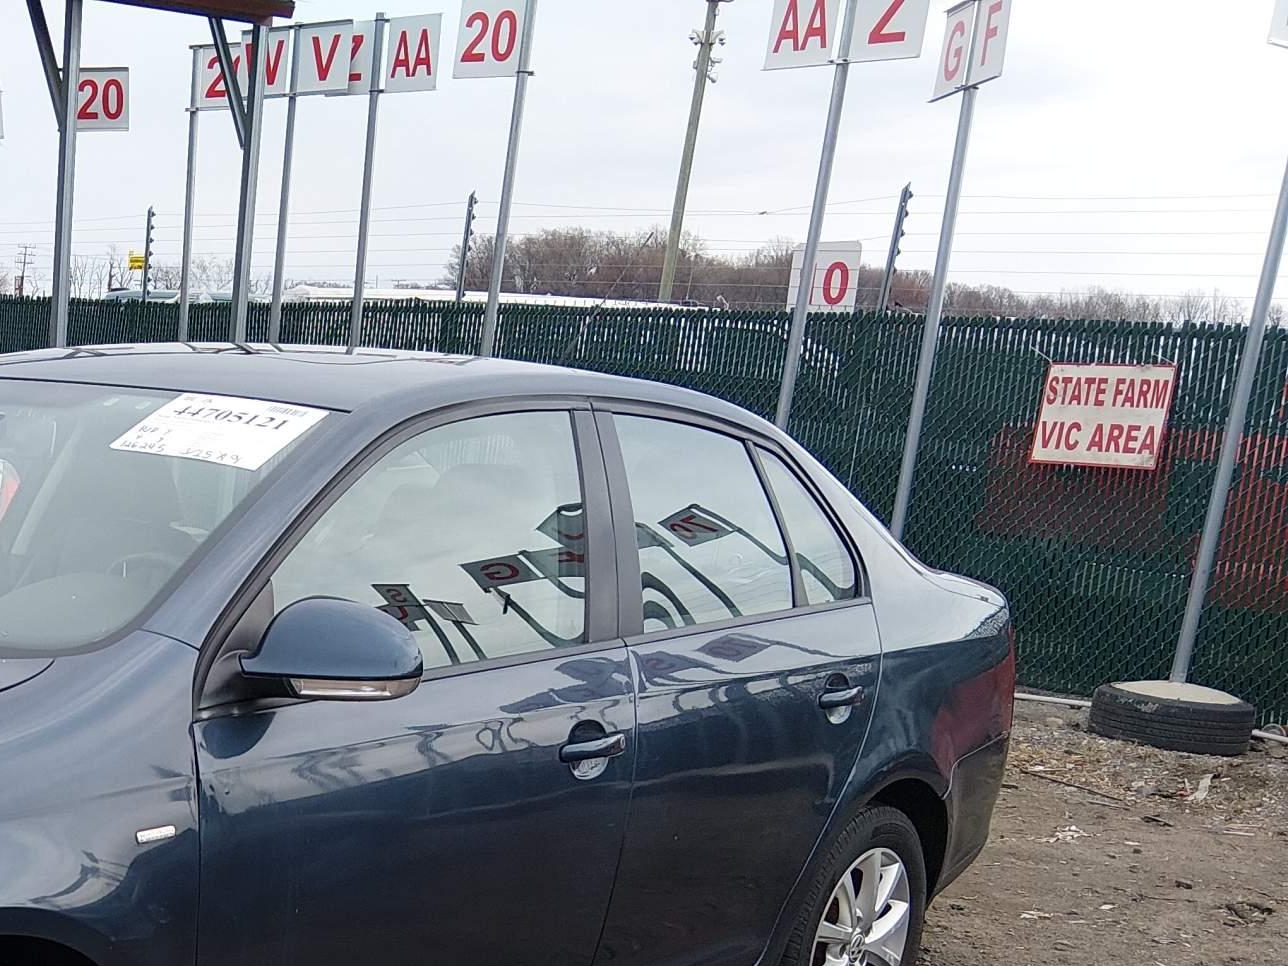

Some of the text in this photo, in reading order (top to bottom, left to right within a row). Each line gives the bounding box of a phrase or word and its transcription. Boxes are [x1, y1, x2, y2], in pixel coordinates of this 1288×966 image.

[460, 9, 518, 63] 20
[772, 0, 827, 53] AA
[943, 20, 964, 82] G
[981, 1, 1003, 66] F
[312, 34, 342, 82] V
[389, 28, 432, 79] AA
[77, 78, 124, 120] 20
[1046, 375, 1170, 409] STATE FARM
[173, 405, 289, 430] 44705121
[1040, 420, 1156, 455] VIC AREA
